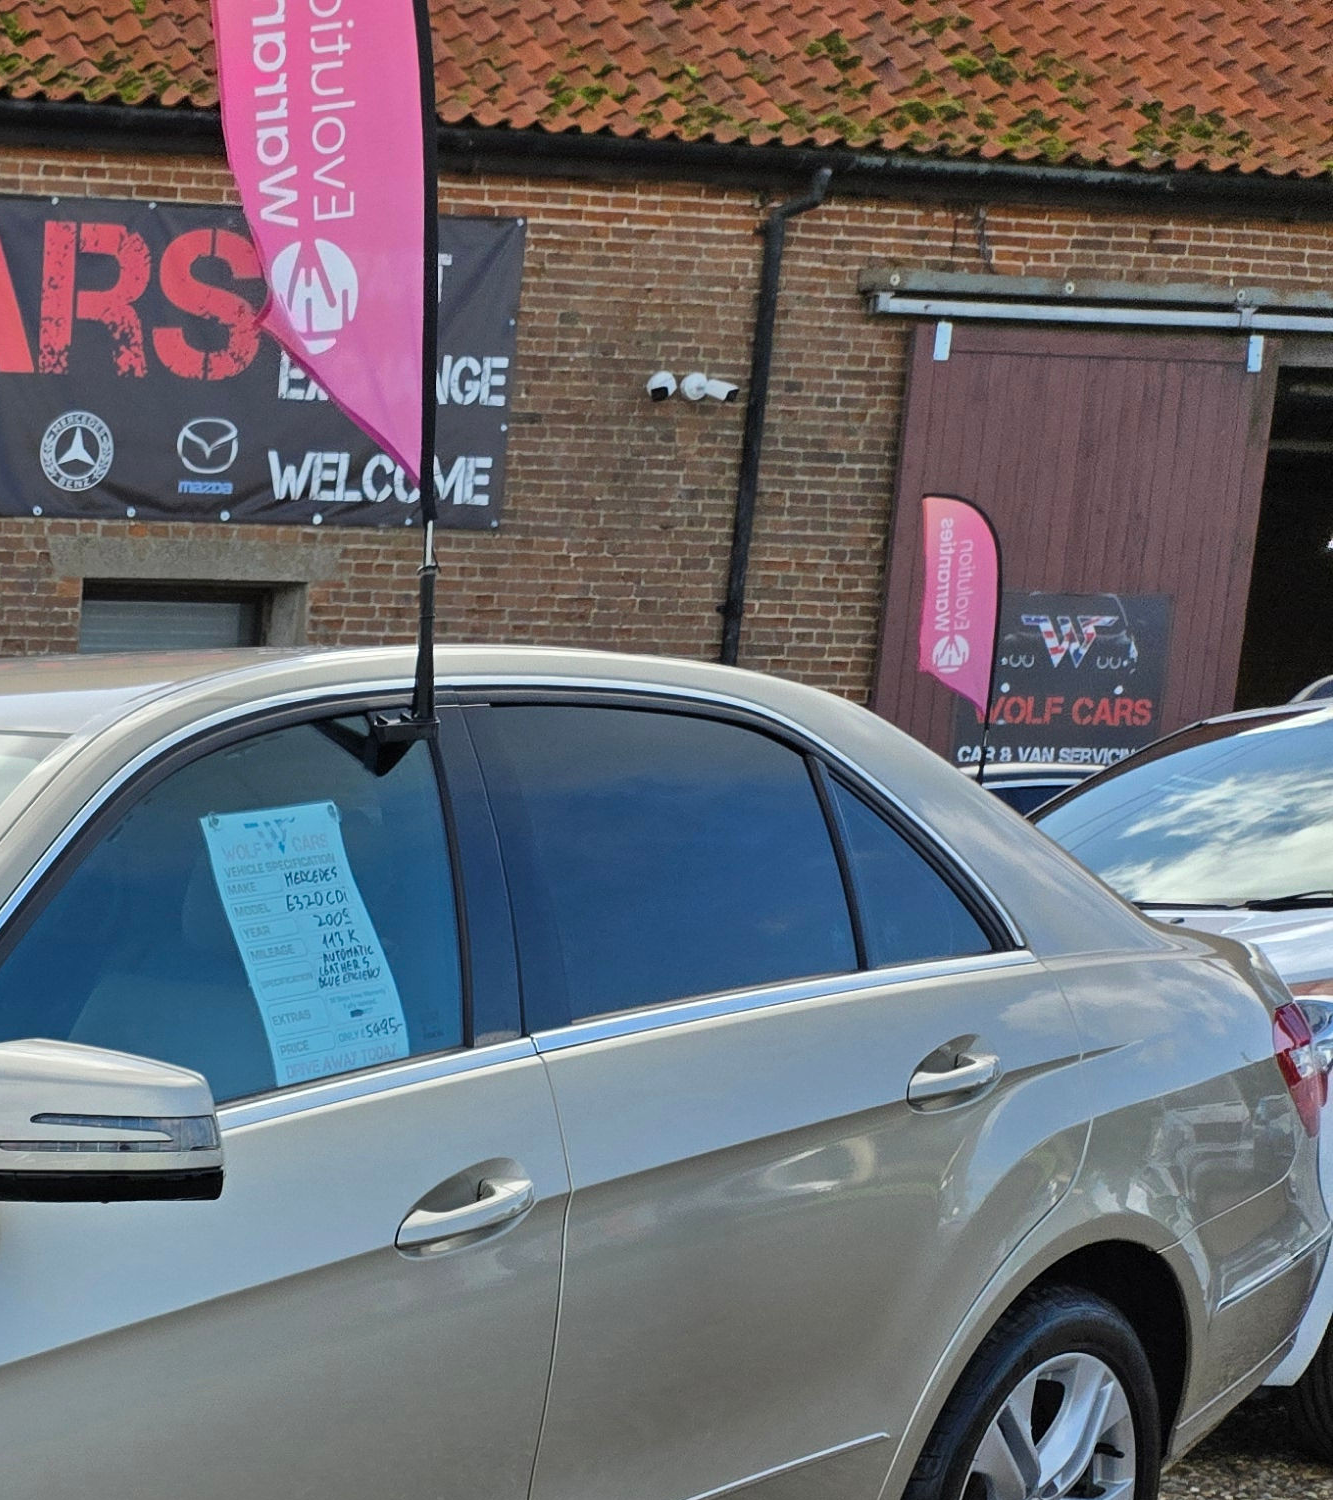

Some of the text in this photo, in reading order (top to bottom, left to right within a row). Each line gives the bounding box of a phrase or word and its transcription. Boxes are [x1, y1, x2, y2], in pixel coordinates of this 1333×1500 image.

[178, 480, 232, 494] mazda
[1071, 696, 1153, 727] CARS
[1000, 746, 1012, 762] &
[1019, 746, 1055, 762] VAN
[292, 834, 328, 852] CARS
[224, 853, 335, 878] VEHICLE SPECIFICATION
[227, 882, 257, 895] MAKE
[234, 903, 271, 917] MODEL
[243, 926, 270, 938] YEAR
[272, 1010, 311, 1026] EXTRAS
[279, 1040, 309, 1053] PRICE
